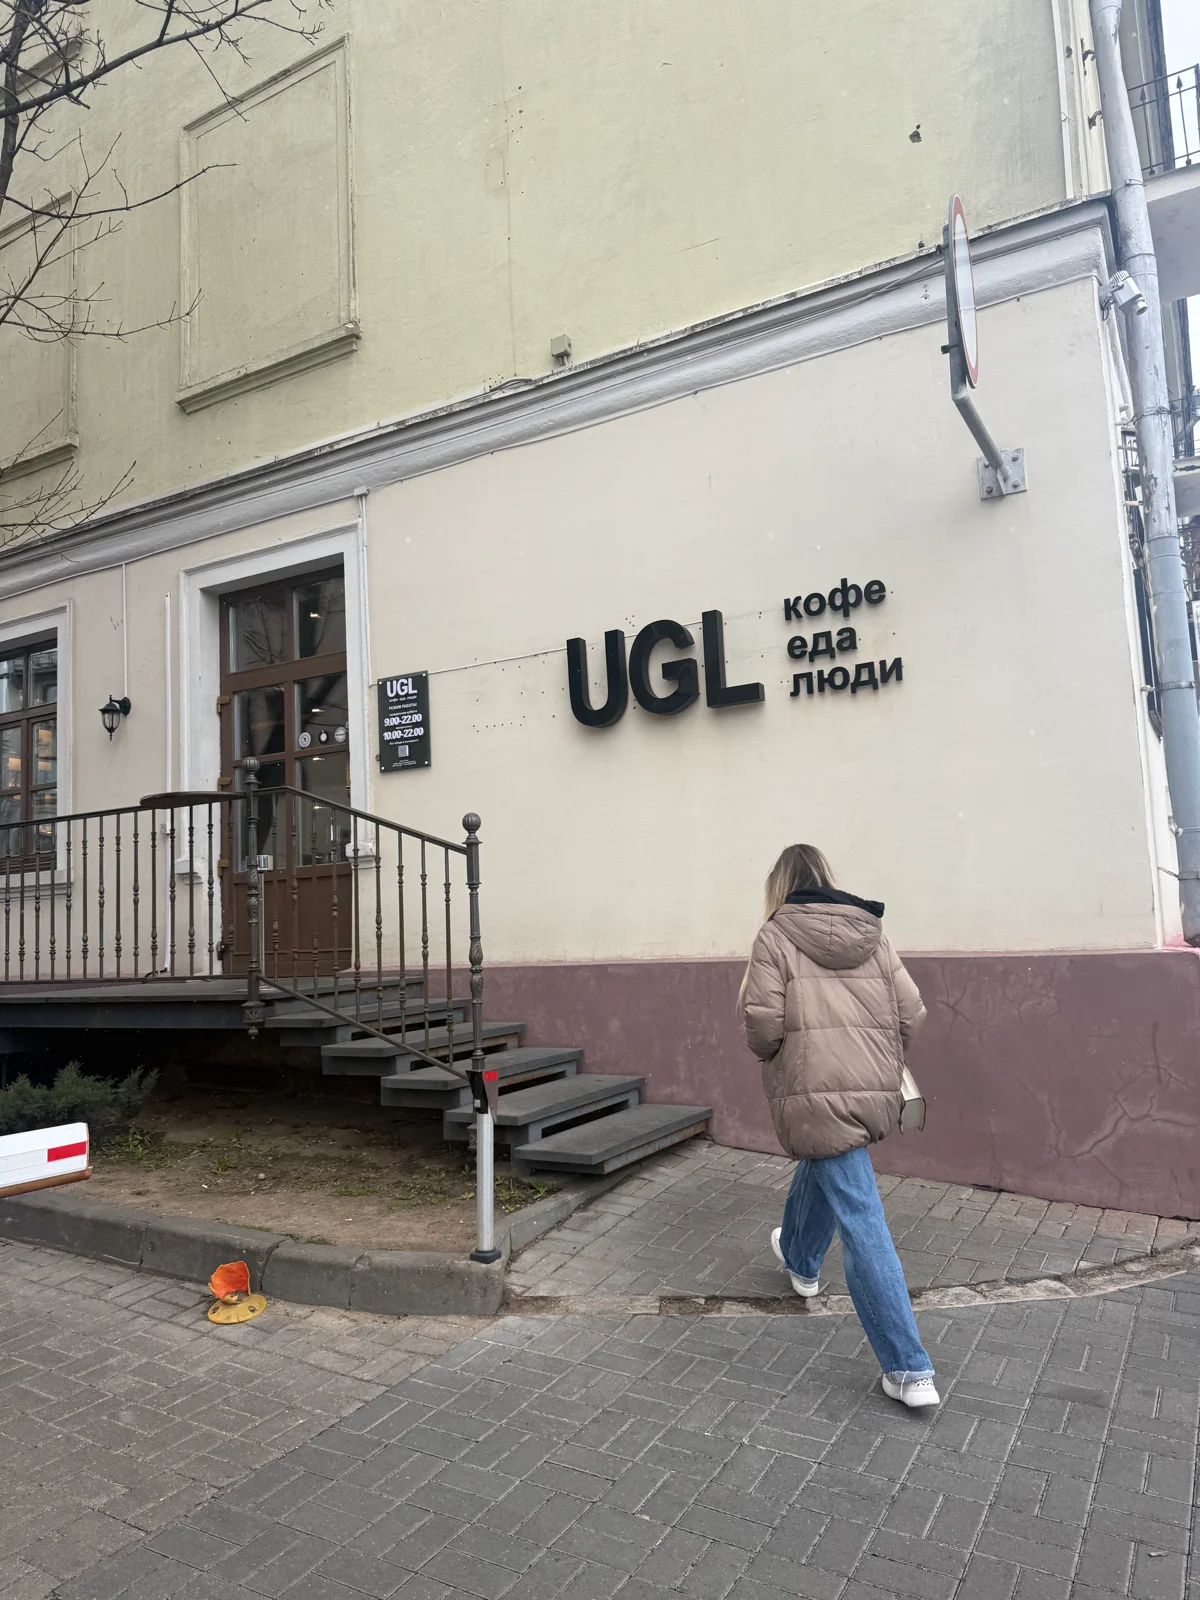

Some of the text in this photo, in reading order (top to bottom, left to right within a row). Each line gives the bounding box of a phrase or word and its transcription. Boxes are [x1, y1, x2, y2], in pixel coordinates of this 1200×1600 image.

[783, 577, 887, 621] кофе
[787, 626, 857, 663] еда
[386, 677, 417, 697] UGL
[566, 609, 766, 729] UGL
[790, 656, 904, 698] люди
[383, 727, 424, 740] 10.00-22.00
[384, 714, 422, 726] 9.00-22.00
